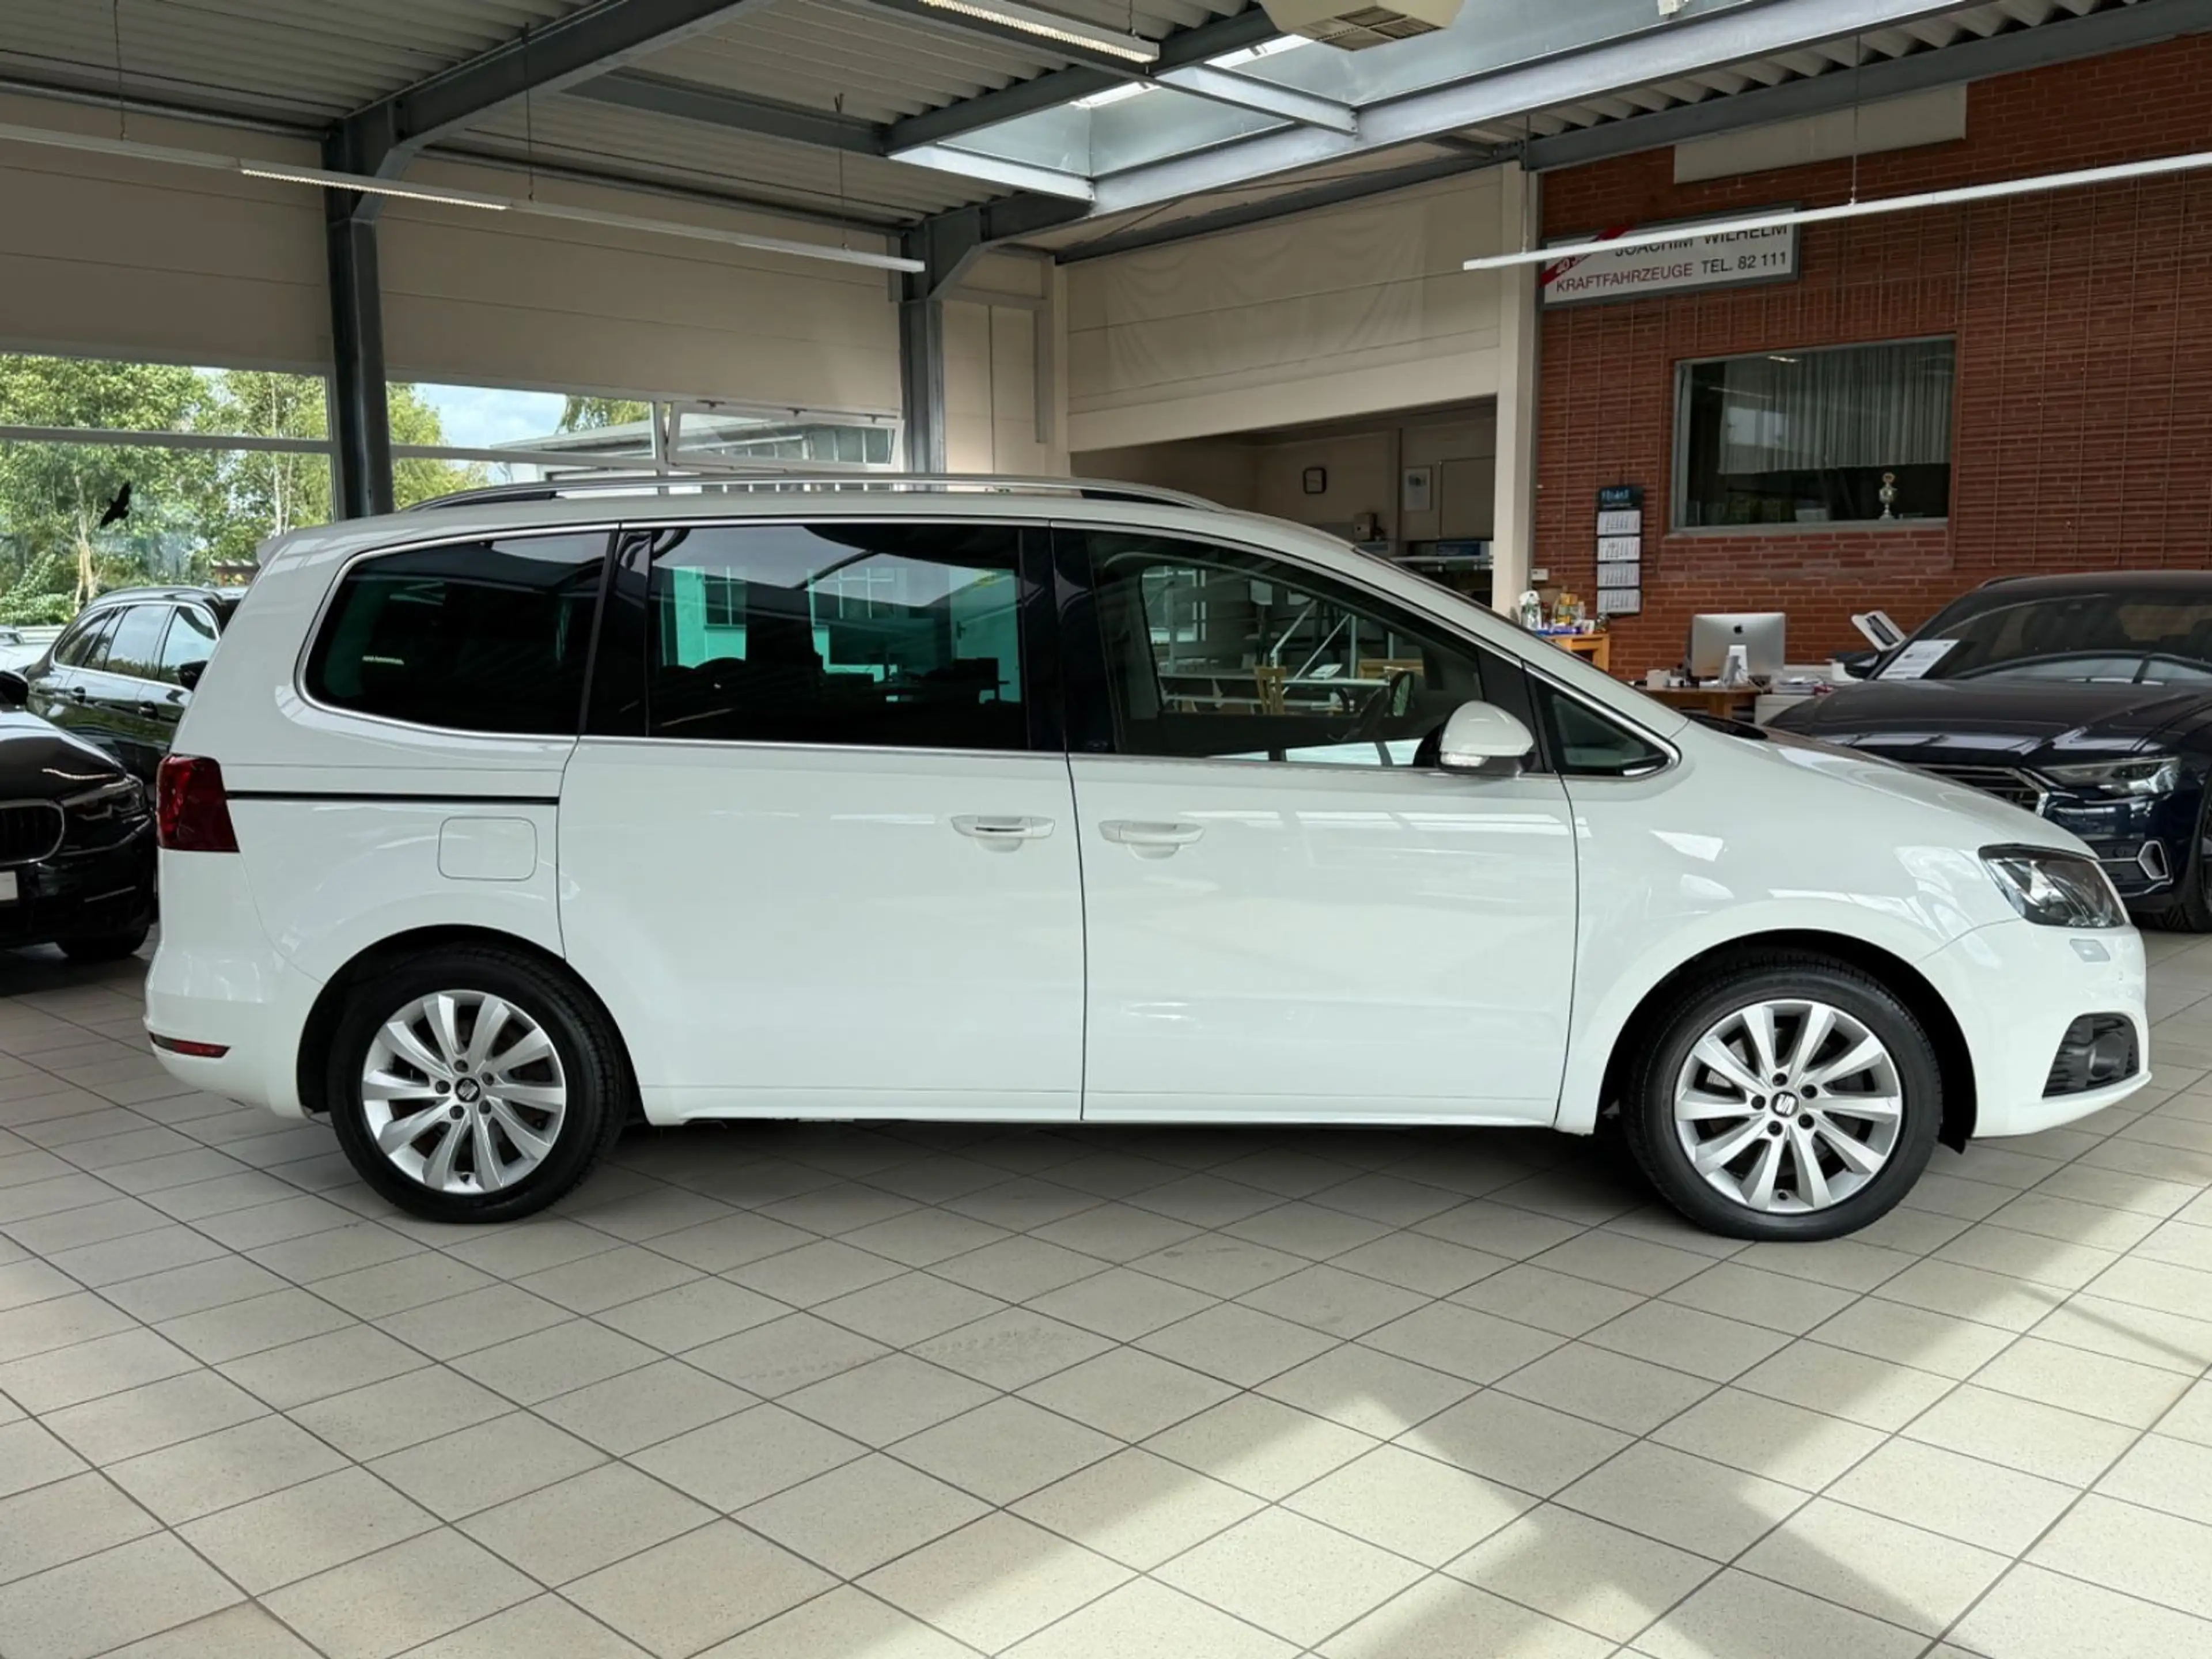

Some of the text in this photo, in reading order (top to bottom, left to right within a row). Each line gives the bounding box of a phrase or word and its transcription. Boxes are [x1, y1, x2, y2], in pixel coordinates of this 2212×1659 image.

[1556, 262, 1693, 293] KRAFTFAHRZEUGE
[1701, 258, 1733, 275] TEL.
[1737, 255, 1757, 270] 82
[1761, 251, 1786, 266] 111
